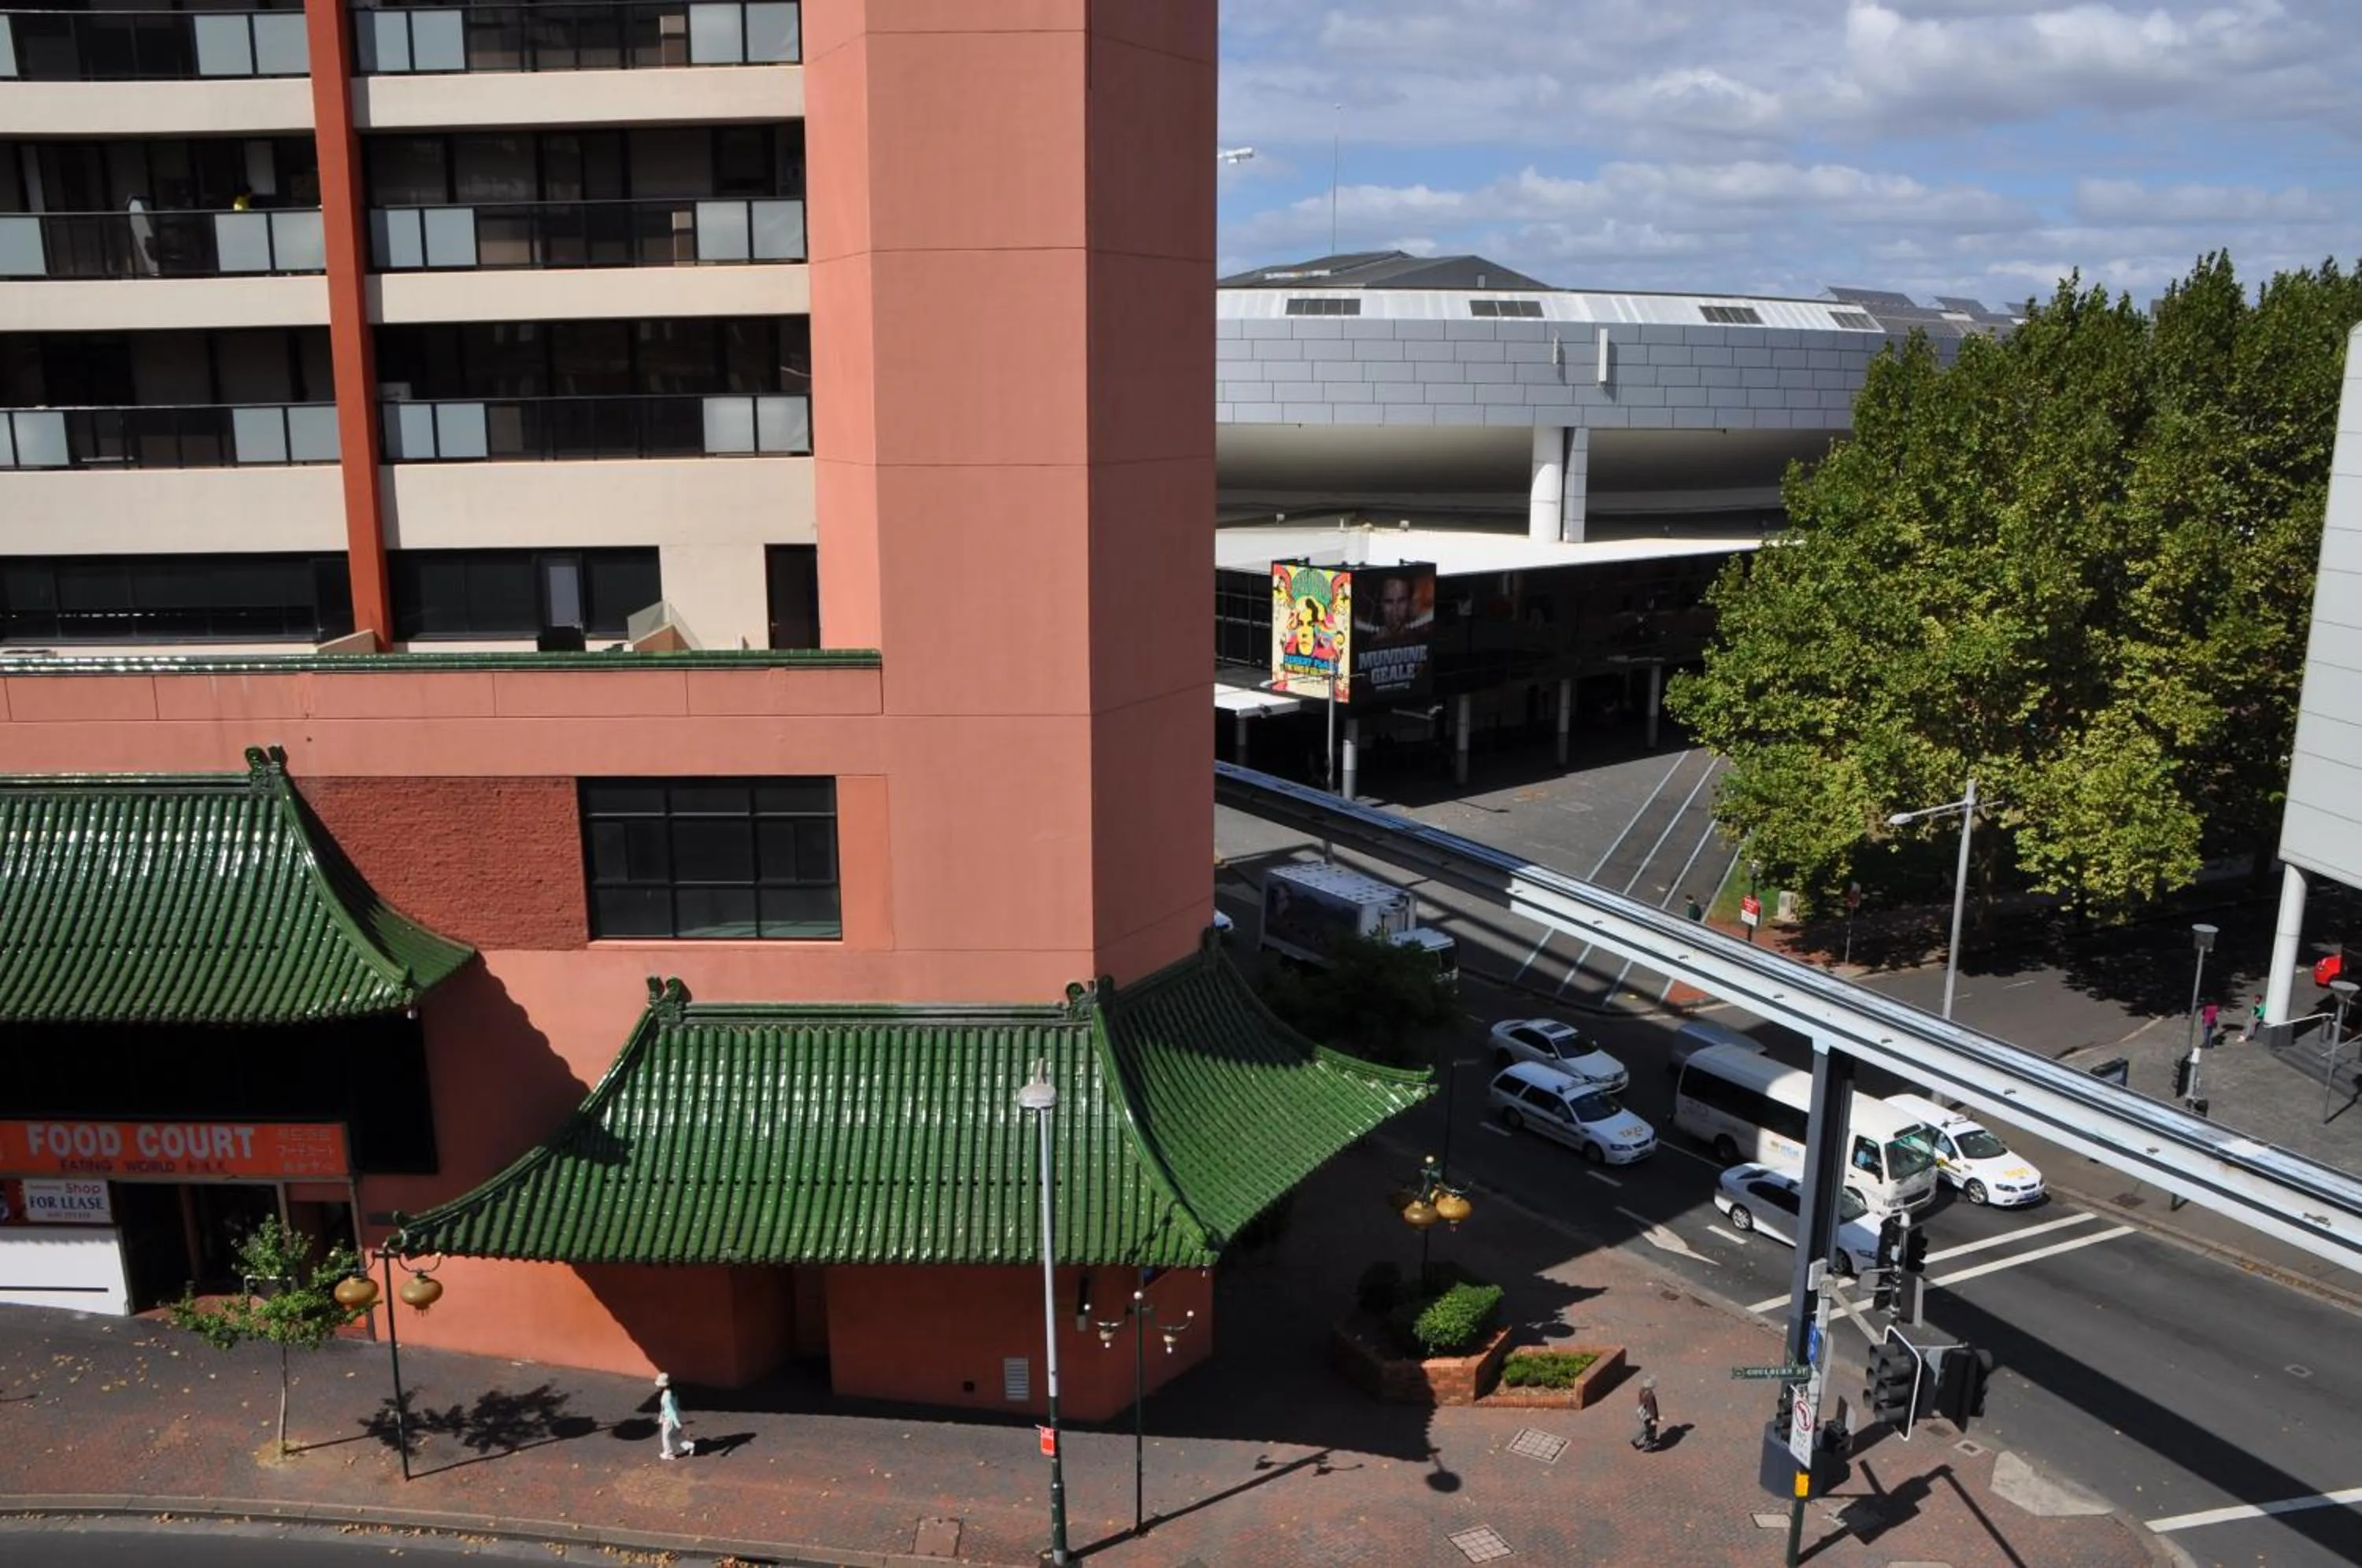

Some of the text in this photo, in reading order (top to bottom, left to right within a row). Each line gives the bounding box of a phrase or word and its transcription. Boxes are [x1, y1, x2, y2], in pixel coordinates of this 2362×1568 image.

[1358, 645, 1428, 669] MUNDINE
[1371, 663, 1416, 685] GEALE
[27, 1122, 122, 1158] FOOD
[137, 1124, 254, 1159] COURT
[61, 1159, 113, 1173] EATING
[65, 1182, 102, 1195] Shop
[29, 1195, 104, 1210] FOR LEASE
